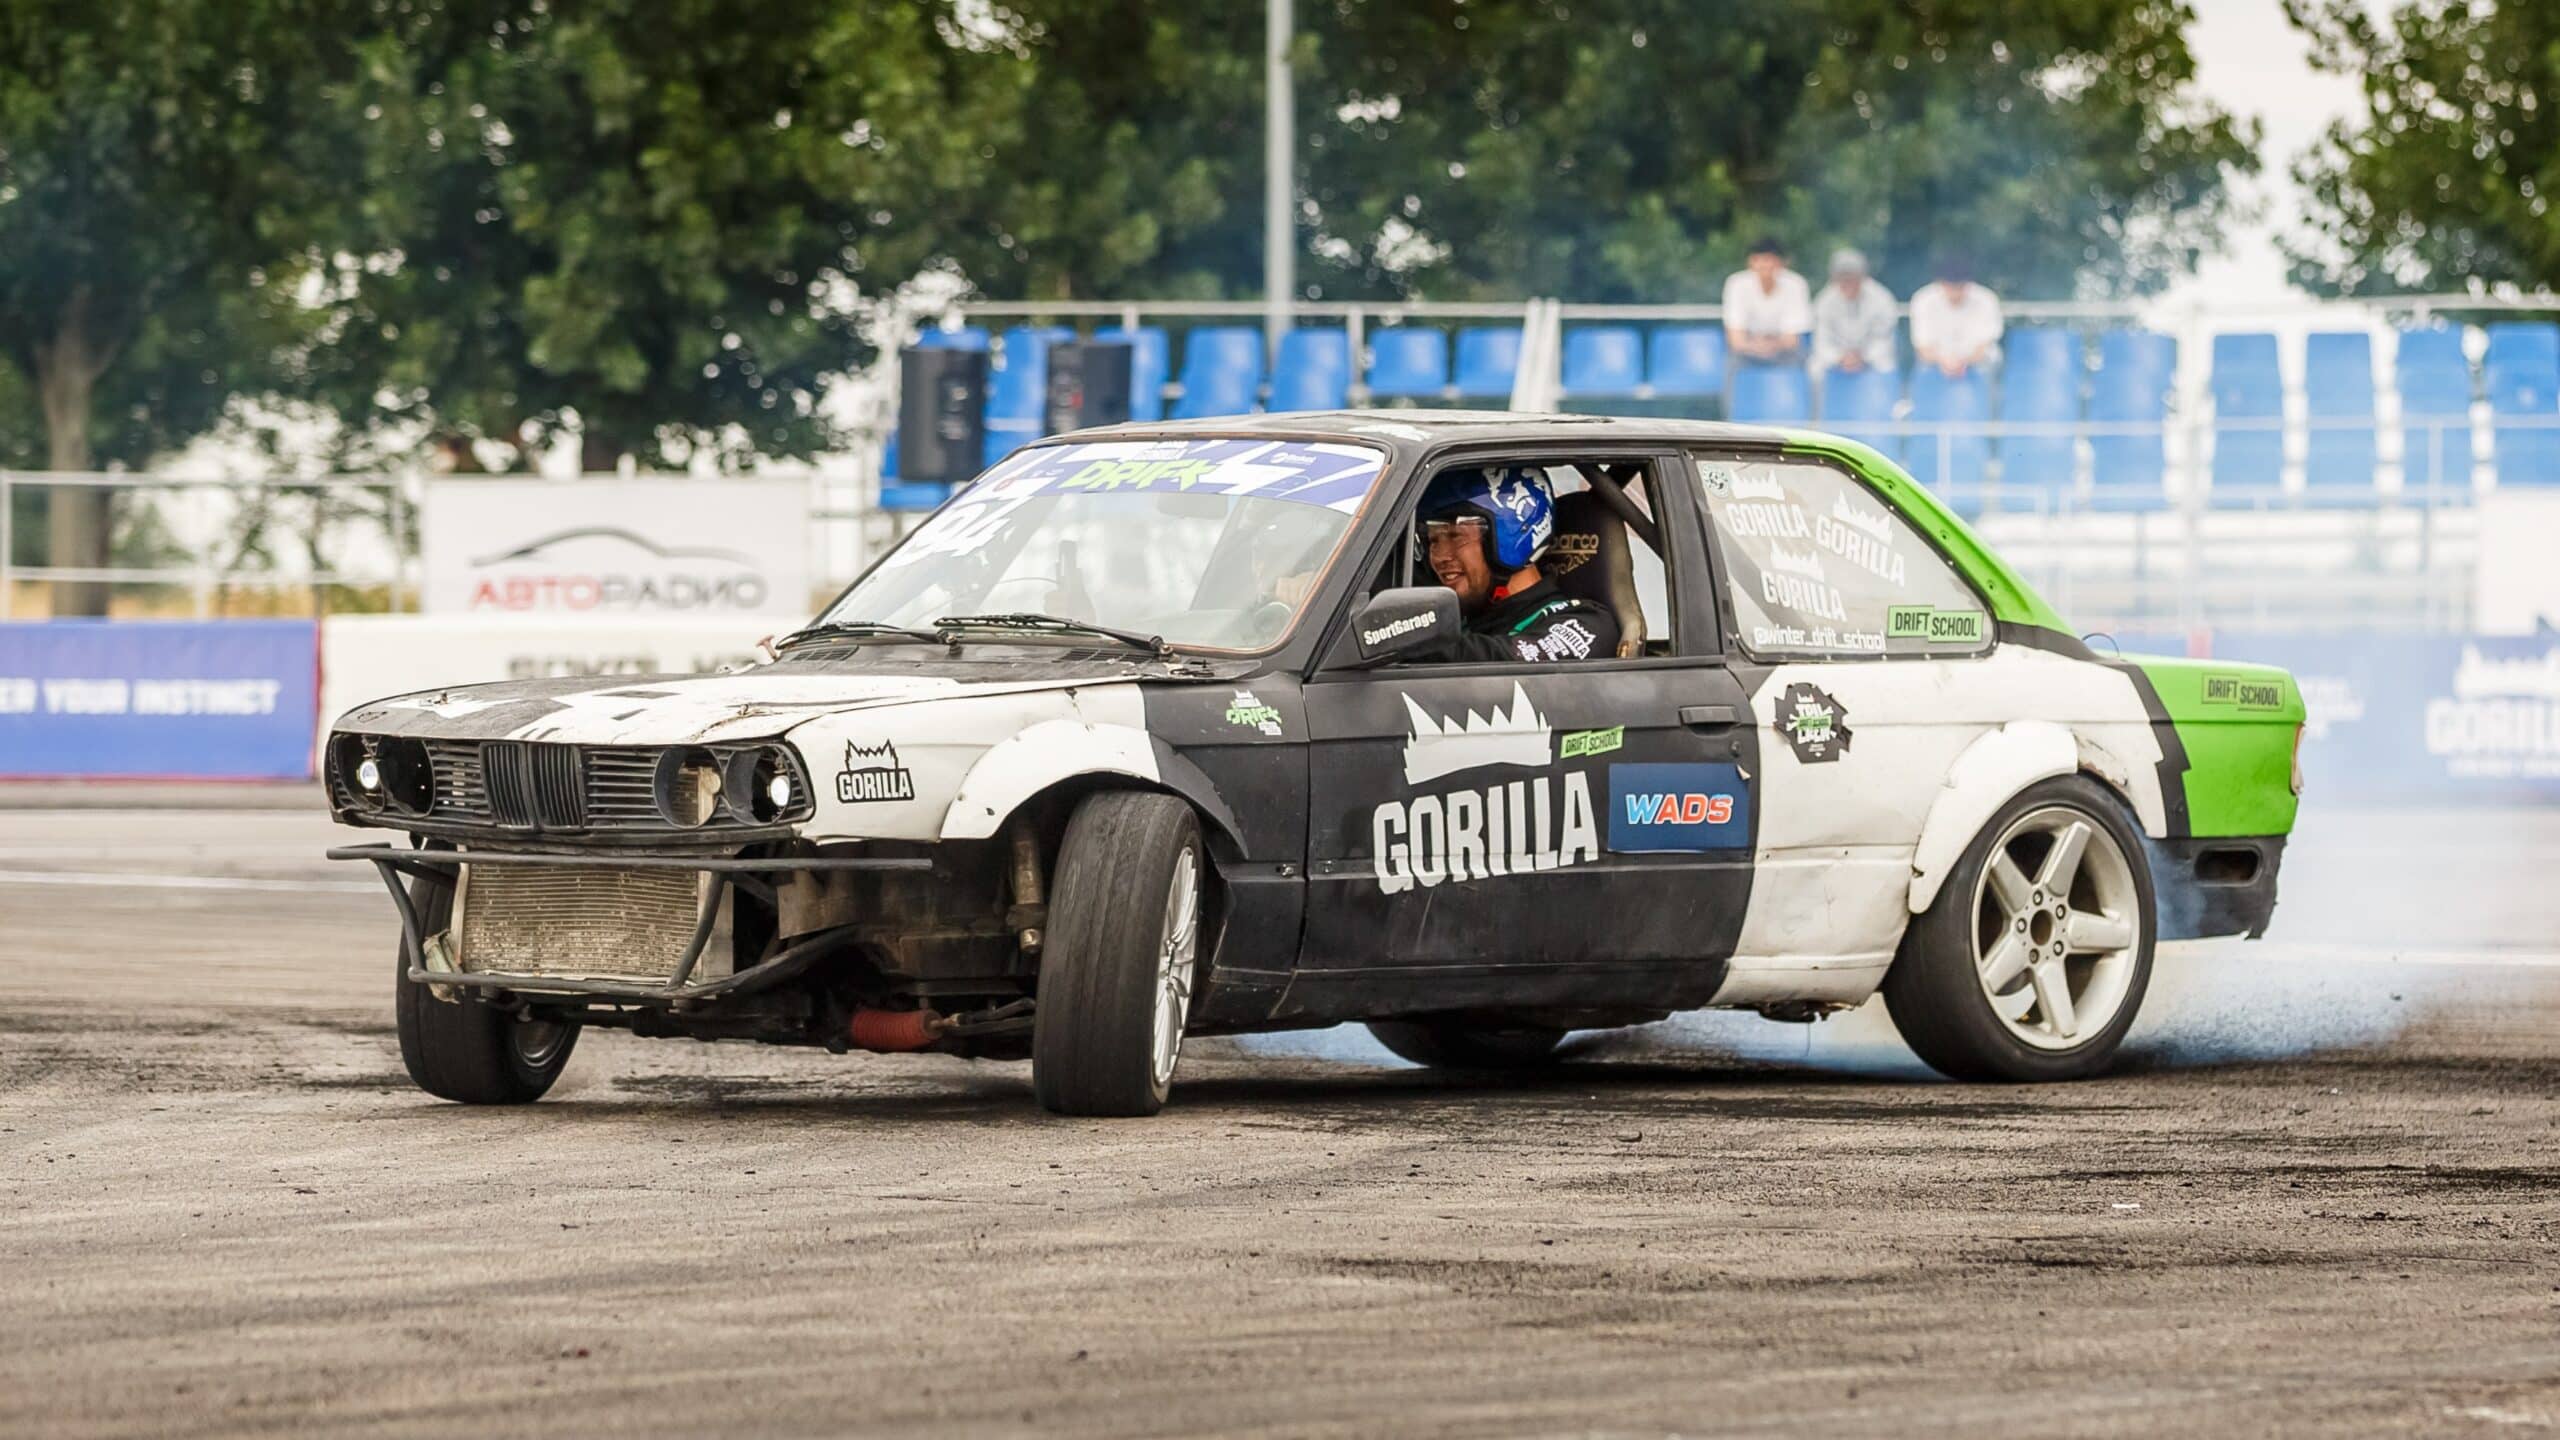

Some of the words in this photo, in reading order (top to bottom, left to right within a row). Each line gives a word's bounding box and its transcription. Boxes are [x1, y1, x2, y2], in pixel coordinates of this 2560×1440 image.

[1726, 503, 1810, 539] GORILLA
[1815, 513, 1904, 587] GORILLA
[470, 573, 768, 611] АВТОРАДИО
[1761, 570, 1847, 622] GORILLA
[1363, 609, 1437, 646] SportGarage
[1551, 624, 1589, 657] GORILLA
[1753, 623, 1886, 652] @winter_drift_school
[1895, 611, 1930, 632] DRIFT
[1931, 617, 1978, 637] SCHOOL
[2208, 679, 2238, 698] DRIFT
[2240, 685, 2280, 706] SCHOOL
[1565, 735, 1587, 753] DRIFT
[1589, 730, 1619, 751] SCHOOL
[838, 770, 913, 801] GORILLA
[1625, 793, 1733, 825] WADS
[1373, 771, 1599, 895] GORILLA
